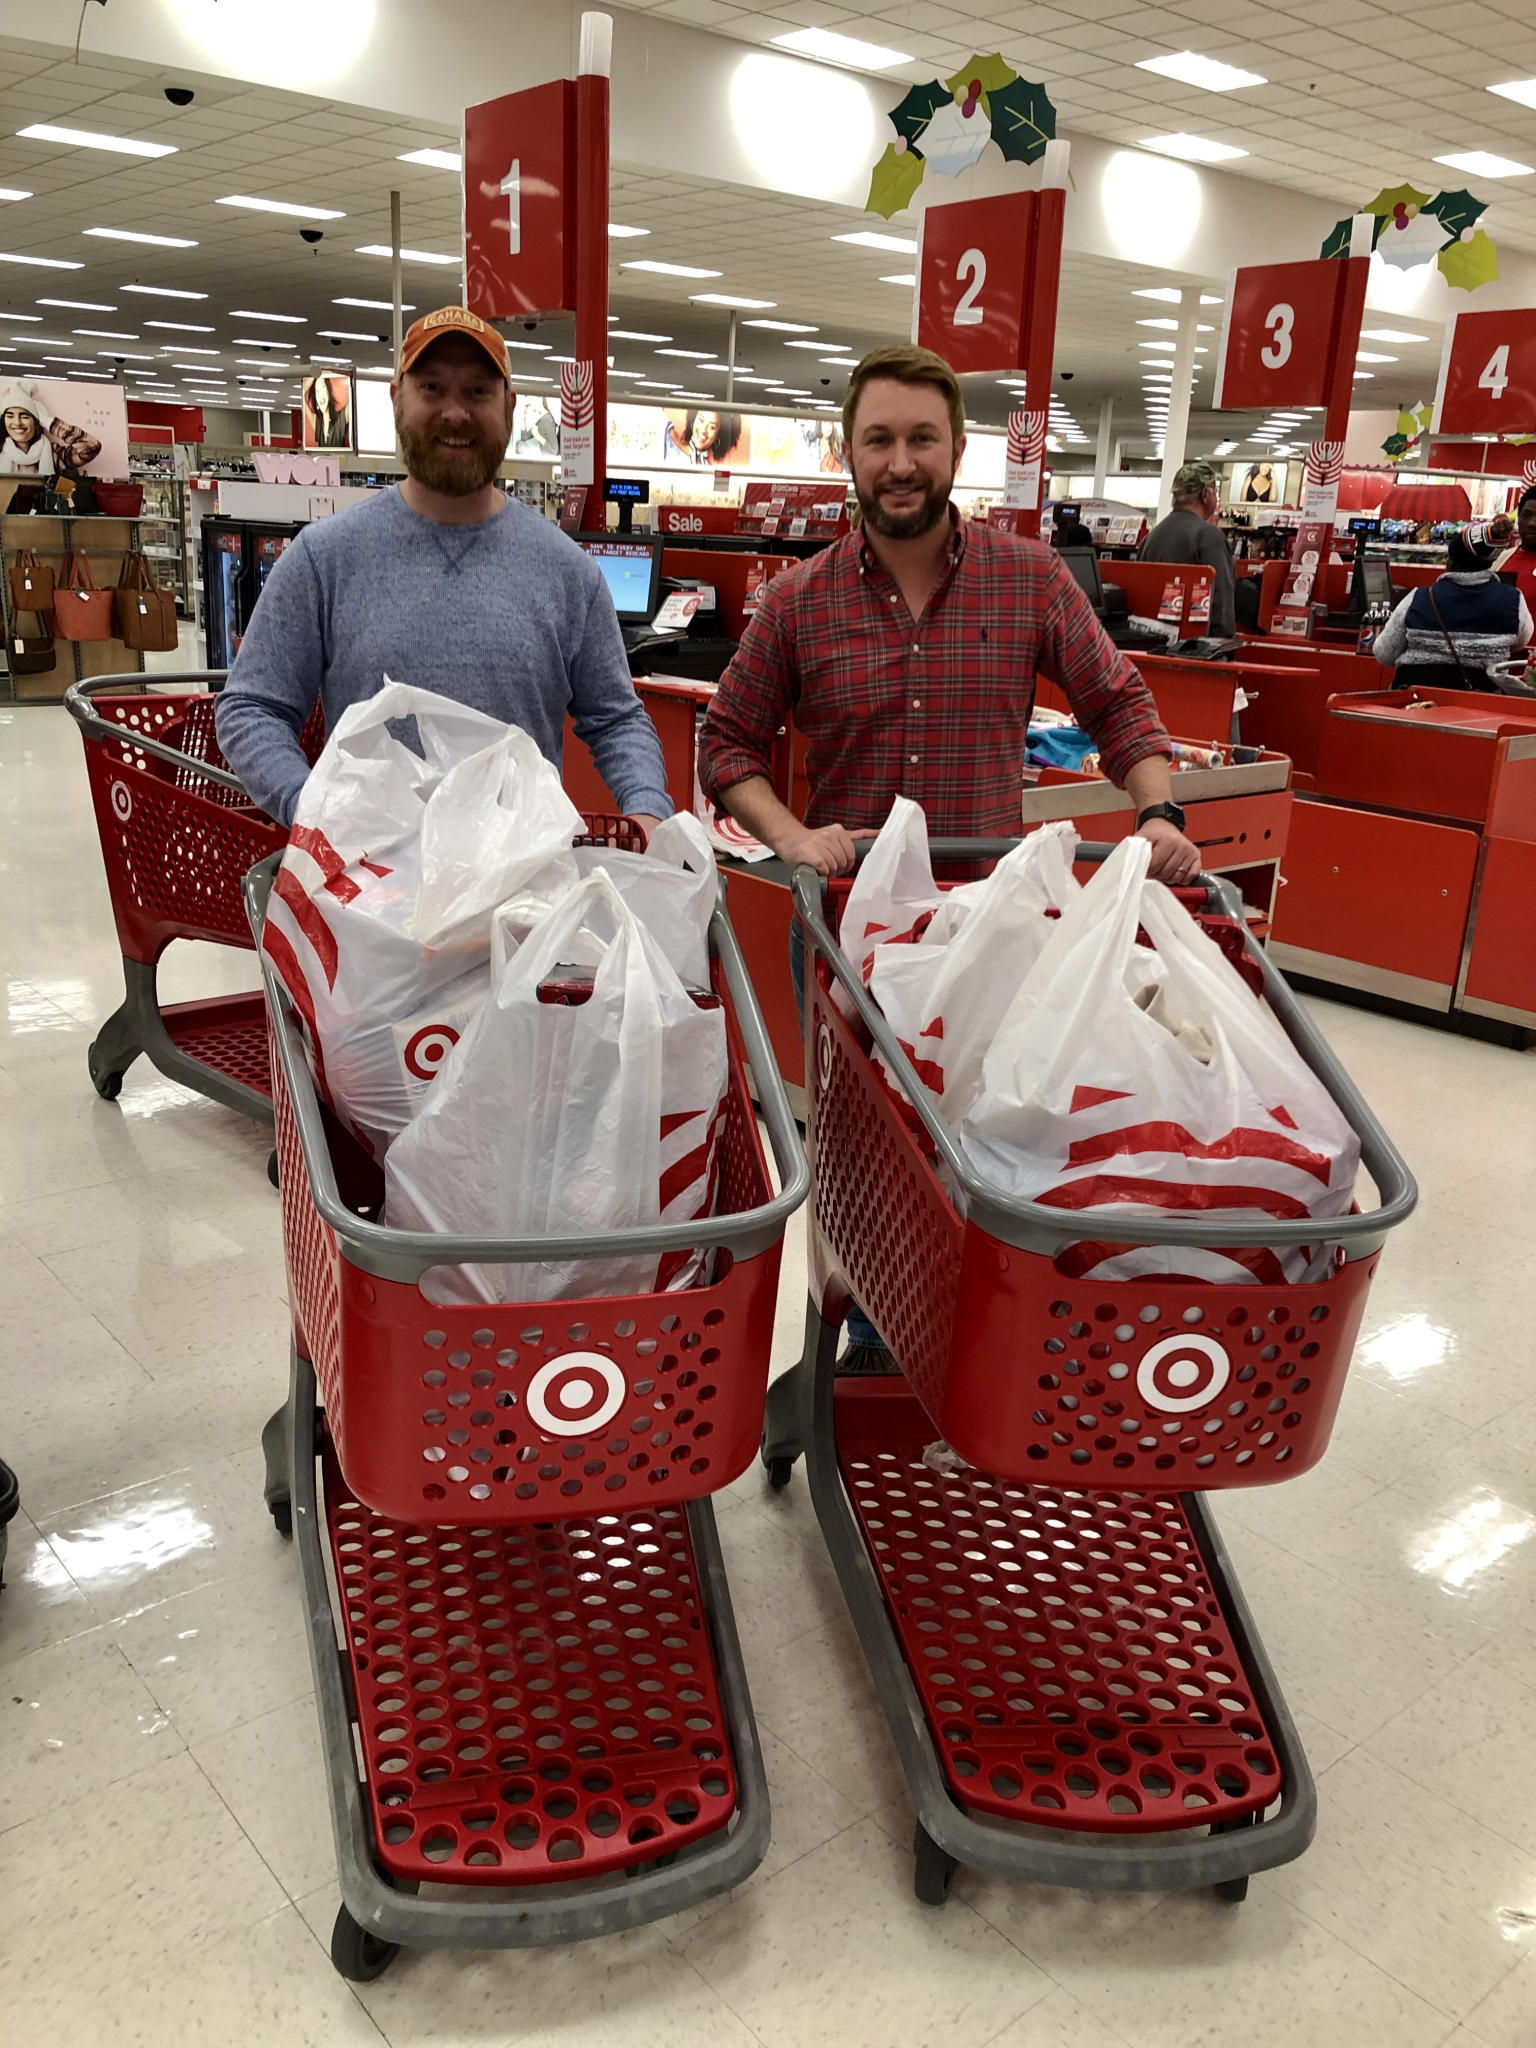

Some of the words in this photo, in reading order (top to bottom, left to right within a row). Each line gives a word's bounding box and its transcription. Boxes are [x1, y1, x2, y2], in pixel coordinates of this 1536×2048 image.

[500, 158, 520, 254] 1
[953, 248, 987, 326] 2
[1261, 303, 1295, 370] 3
[1478, 344, 1510, 400] 4
[86, 418, 105, 427] day
[668, 512, 703, 533] Sale
